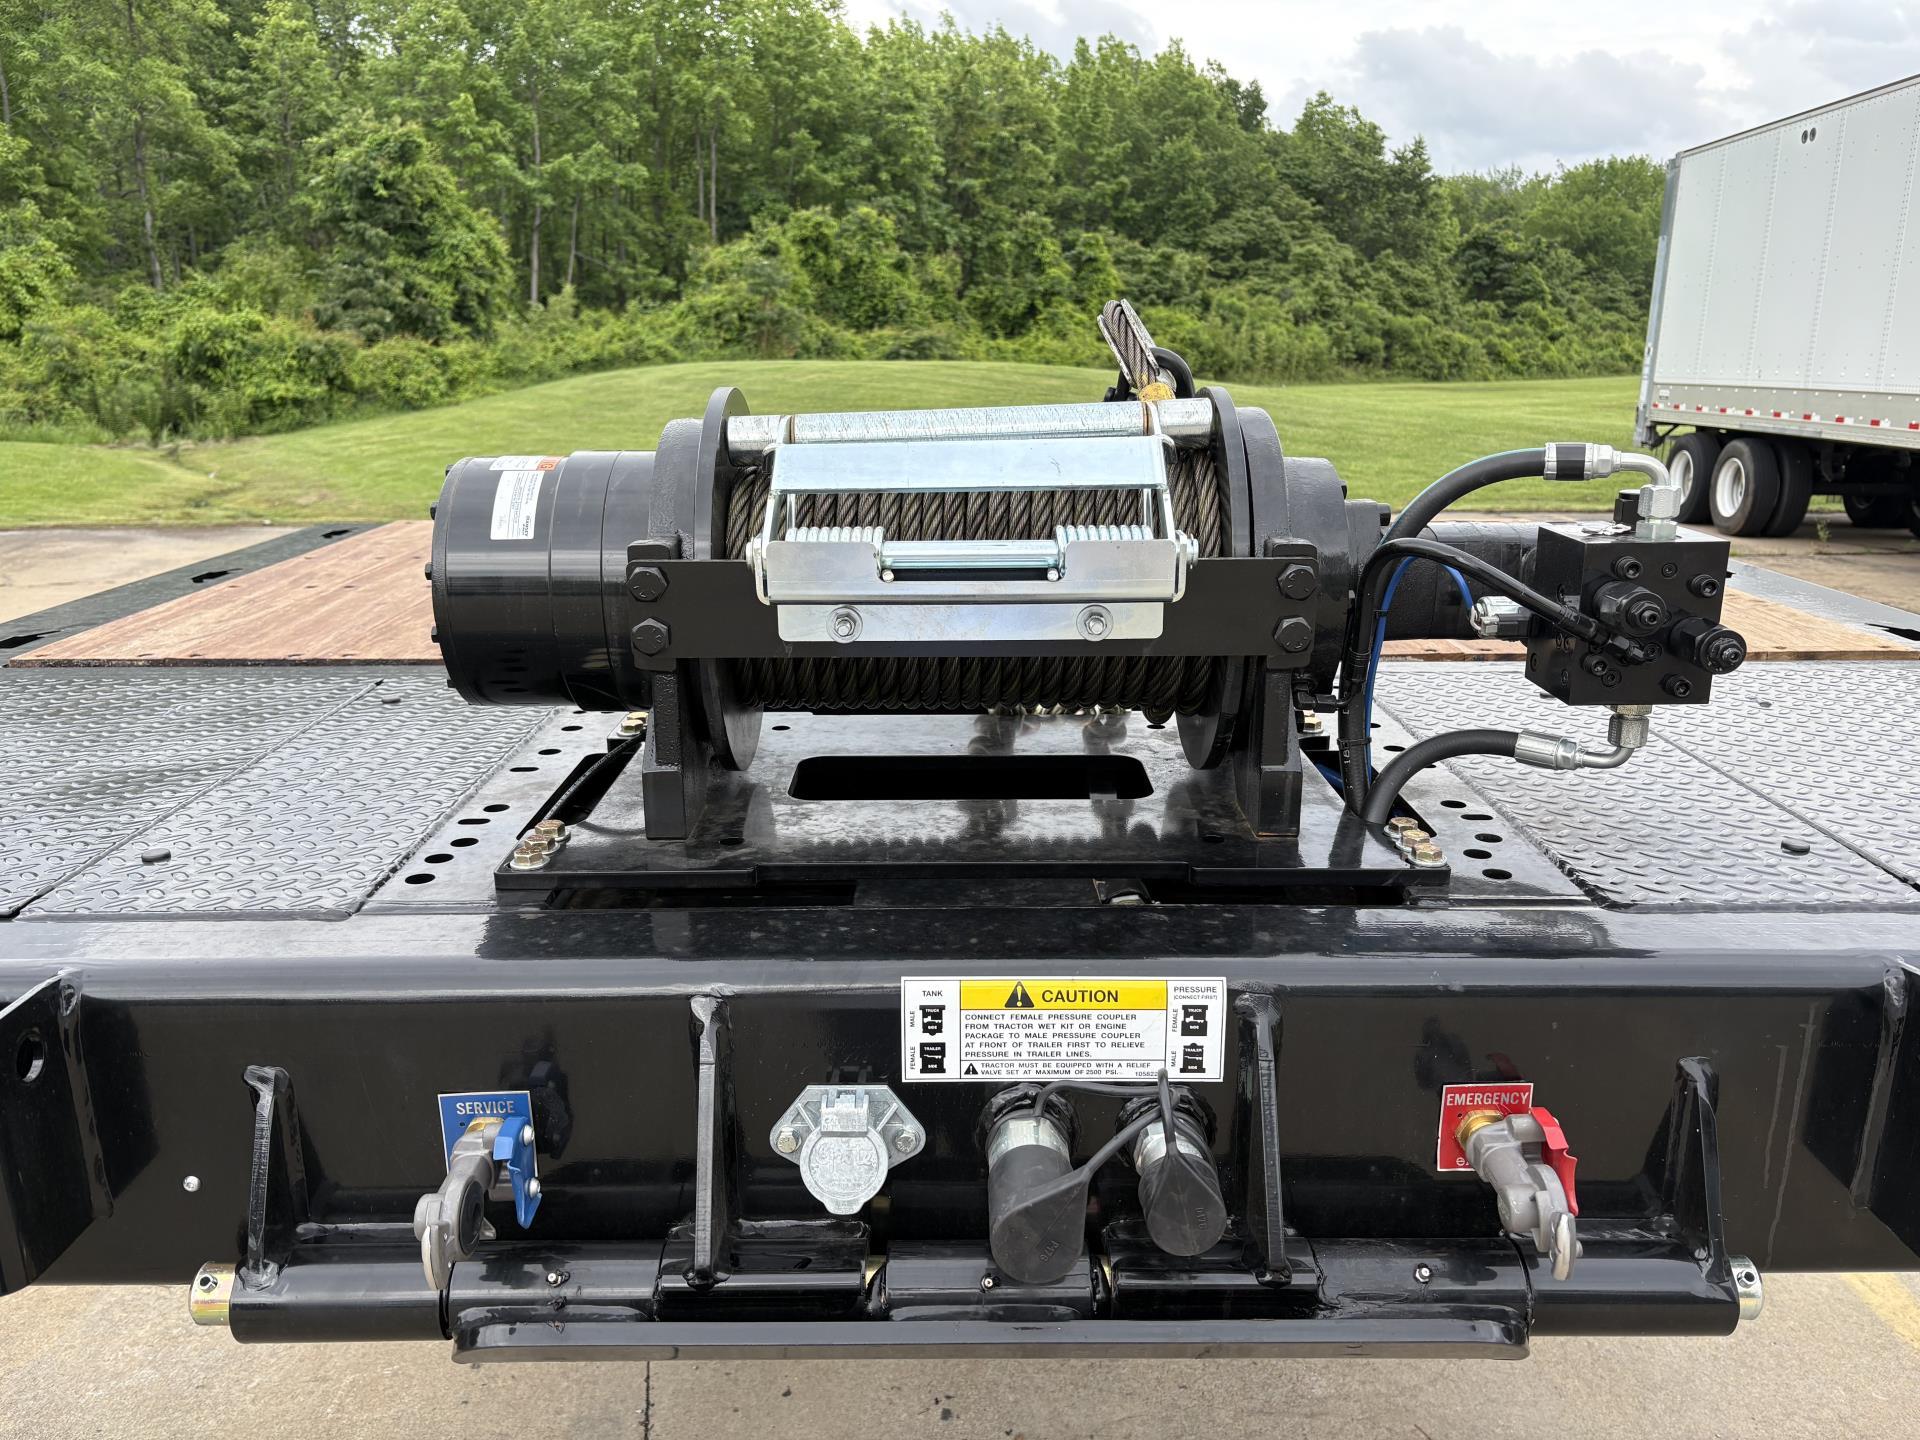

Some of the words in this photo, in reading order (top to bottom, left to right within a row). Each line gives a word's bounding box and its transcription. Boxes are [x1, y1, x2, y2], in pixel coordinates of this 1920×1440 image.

[1041, 989, 1119, 1003] CAUTION
[1446, 1092, 1530, 1106] EMERGENCY
[456, 1100, 515, 1114] SERVICE
